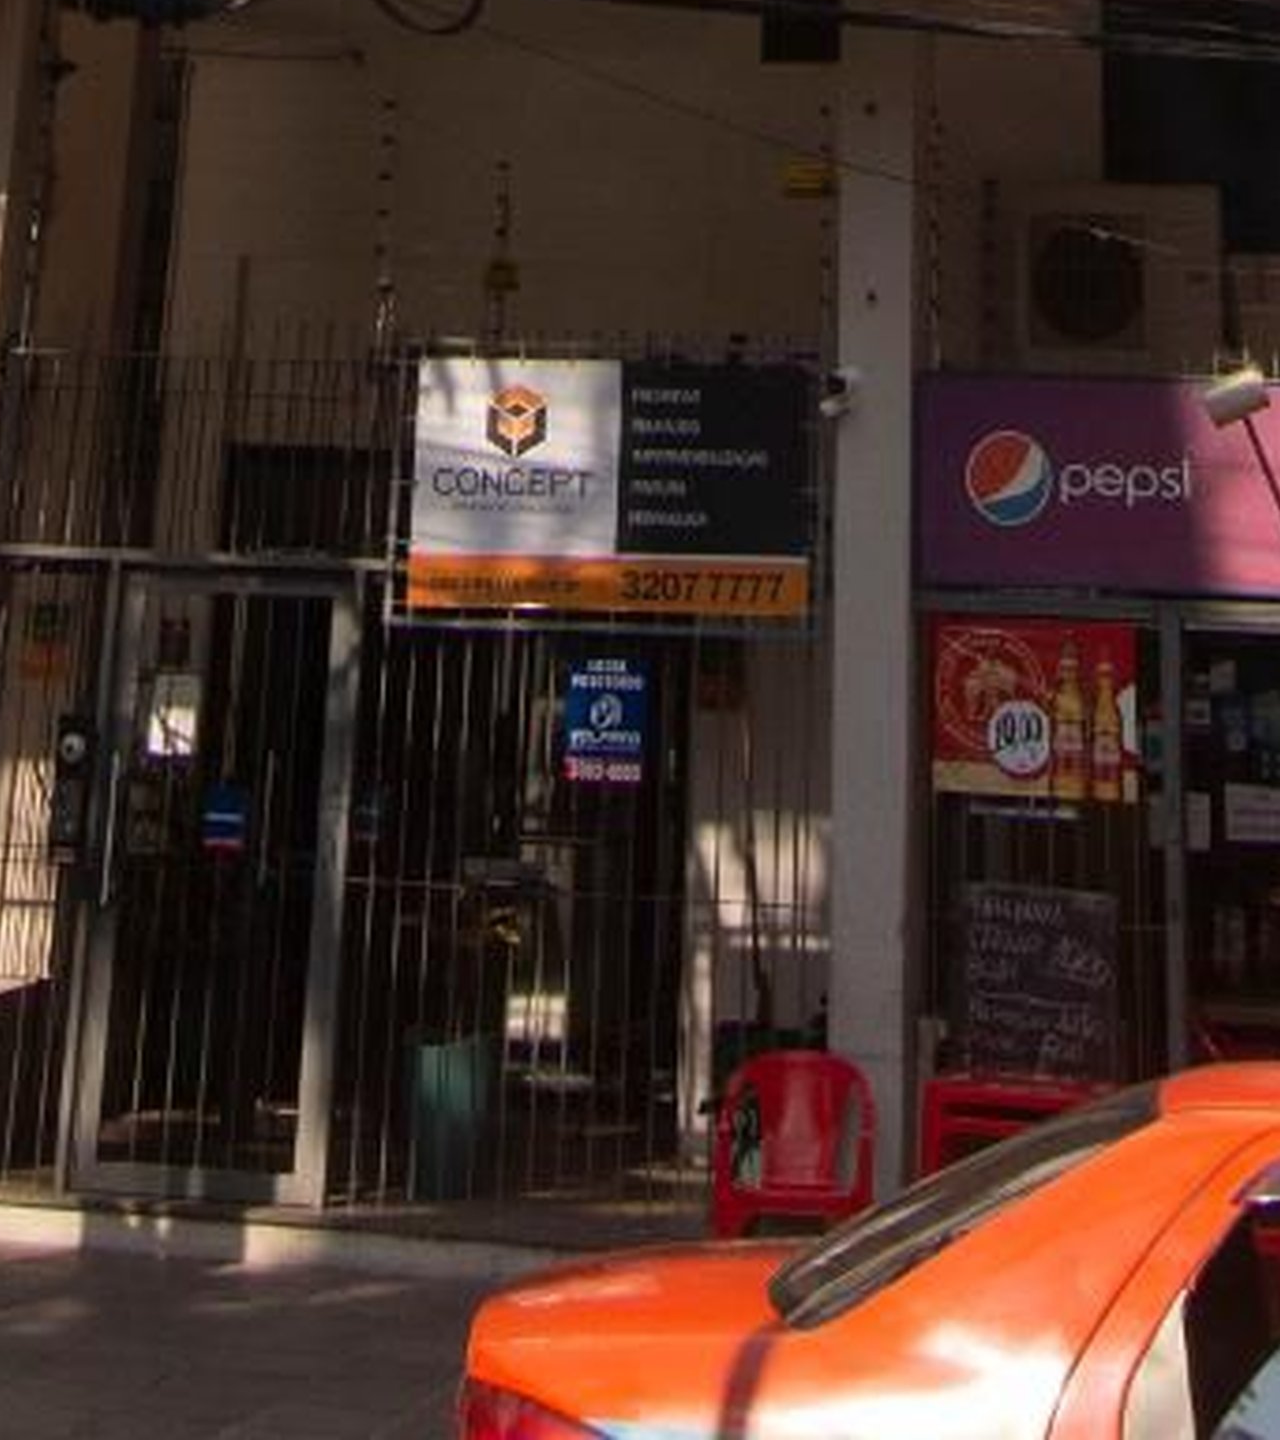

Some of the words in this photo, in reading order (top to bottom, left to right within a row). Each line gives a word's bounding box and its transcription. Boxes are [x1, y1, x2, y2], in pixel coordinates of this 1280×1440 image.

[433, 466, 597, 498] CONCEPT
[1059, 454, 1191, 508] pepsi
[621, 569, 698, 601] 3207
